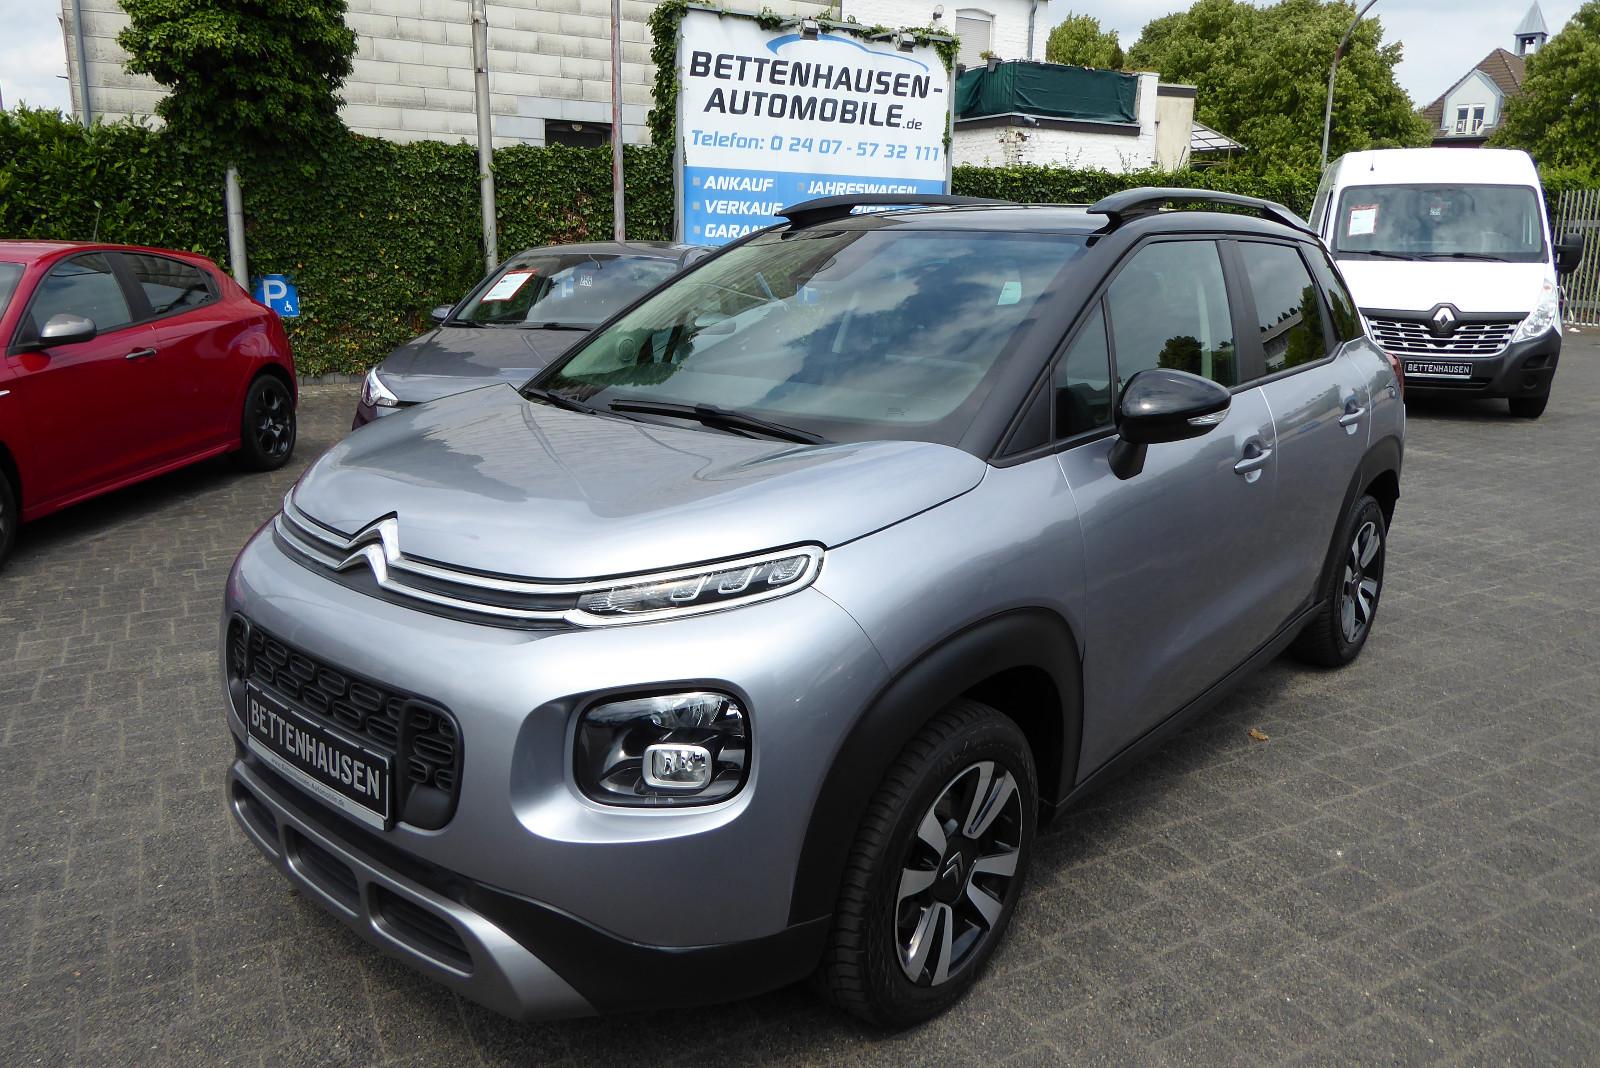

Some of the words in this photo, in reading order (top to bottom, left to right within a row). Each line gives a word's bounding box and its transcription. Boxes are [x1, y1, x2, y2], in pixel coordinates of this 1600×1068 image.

[692, 129, 764, 150] Telefon:
[770, 135, 783, 150] 0
[789, 137, 813, 152] 24
[819, 140, 842, 154] 07
[857, 142, 879, 157] 57
[884, 144, 907, 159] 32
[915, 146, 939, 161] 111
[704, 175, 774, 192] ANKAUF
[705, 200, 783, 216] VERKAUF
[263, 279, 287, 308] P
[1407, 363, 1470, 374] BETTENHAUSEN
[251, 699, 380, 800] BETTENHAUSEN
